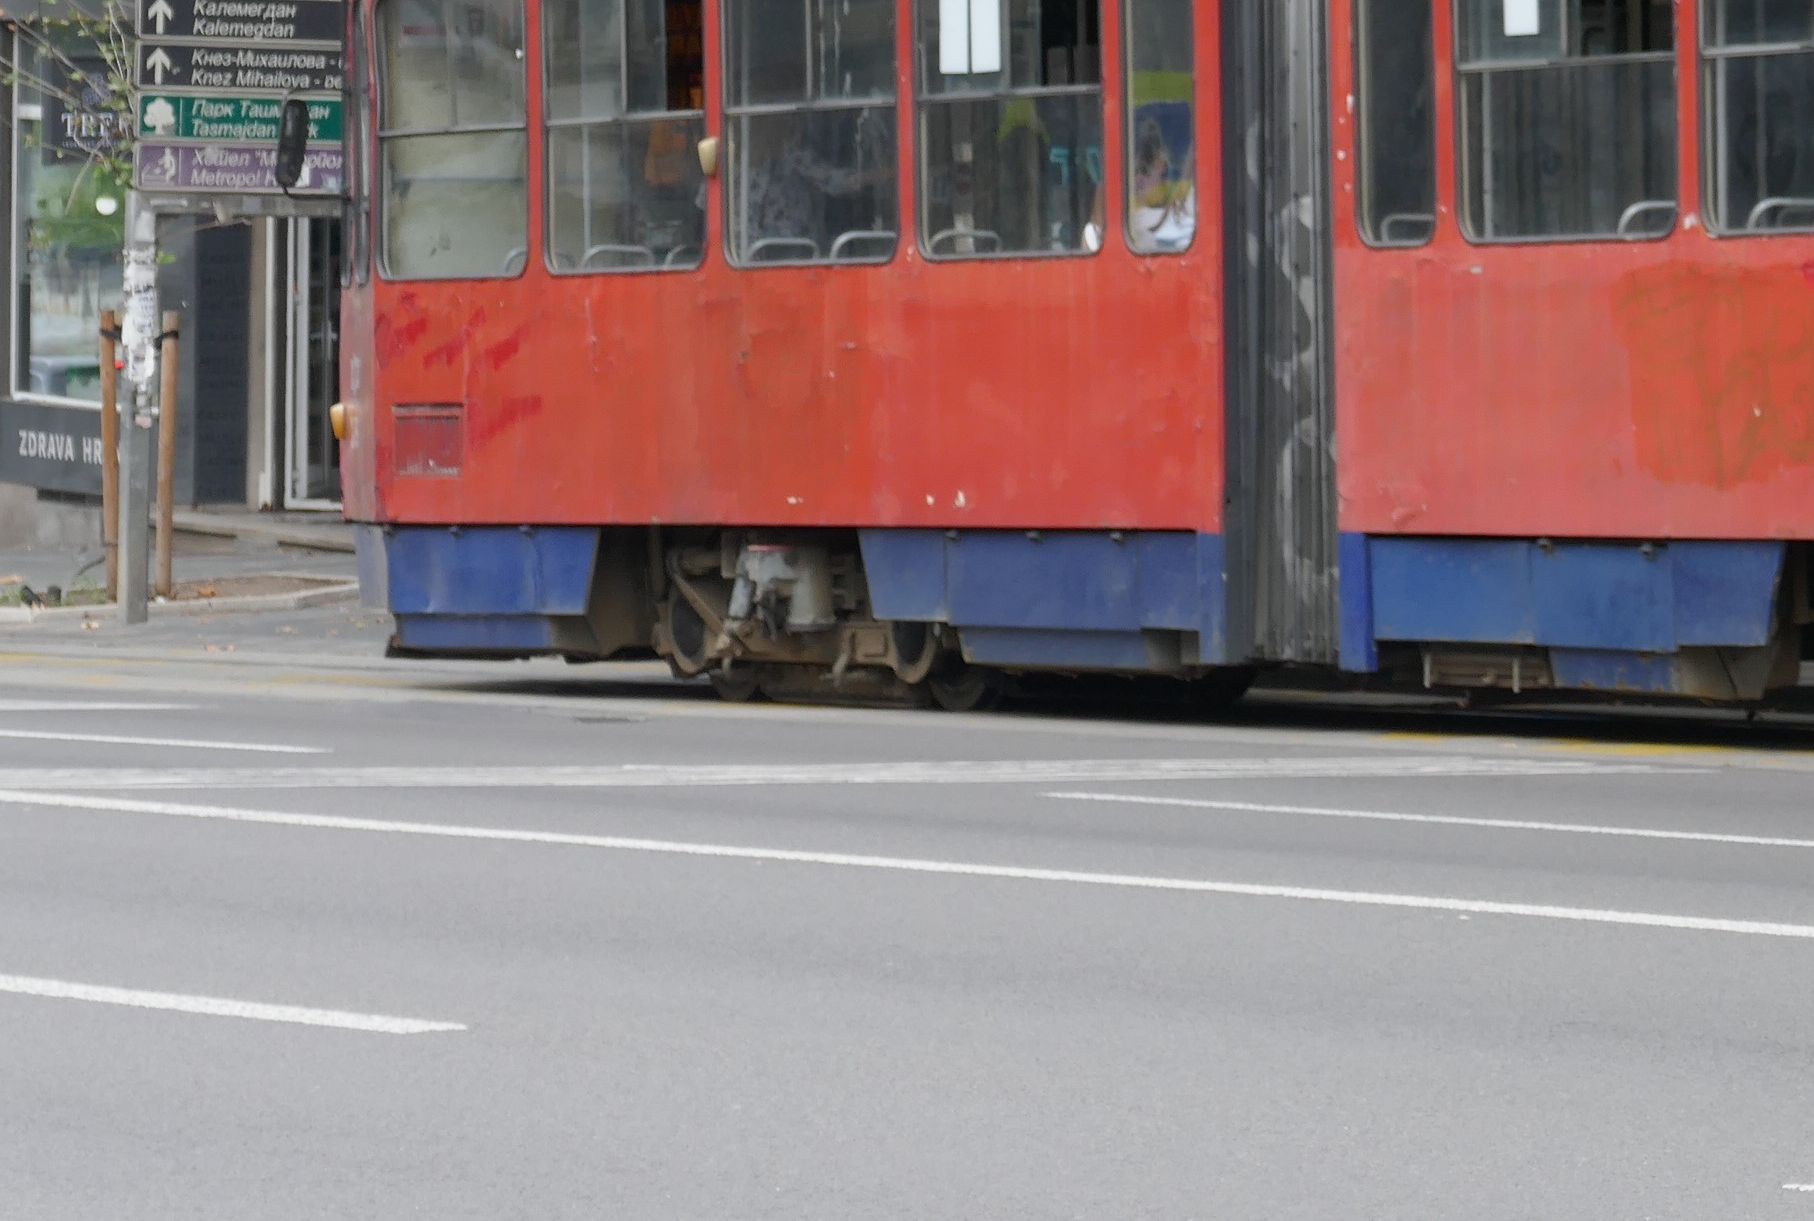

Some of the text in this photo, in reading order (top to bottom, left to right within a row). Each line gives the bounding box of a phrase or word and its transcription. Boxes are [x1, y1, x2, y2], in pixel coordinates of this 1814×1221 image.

[193, 17, 295, 40] Kalemegdan
[191, 67, 233, 87] Knez
[236, 69, 310, 89] Mihailova
[192, 99, 234, 119] Парк
[192, 118, 276, 140] Tasmajdan
[191, 168, 261, 188] Metropol
[18, 429, 75, 462] ZDRAVA
